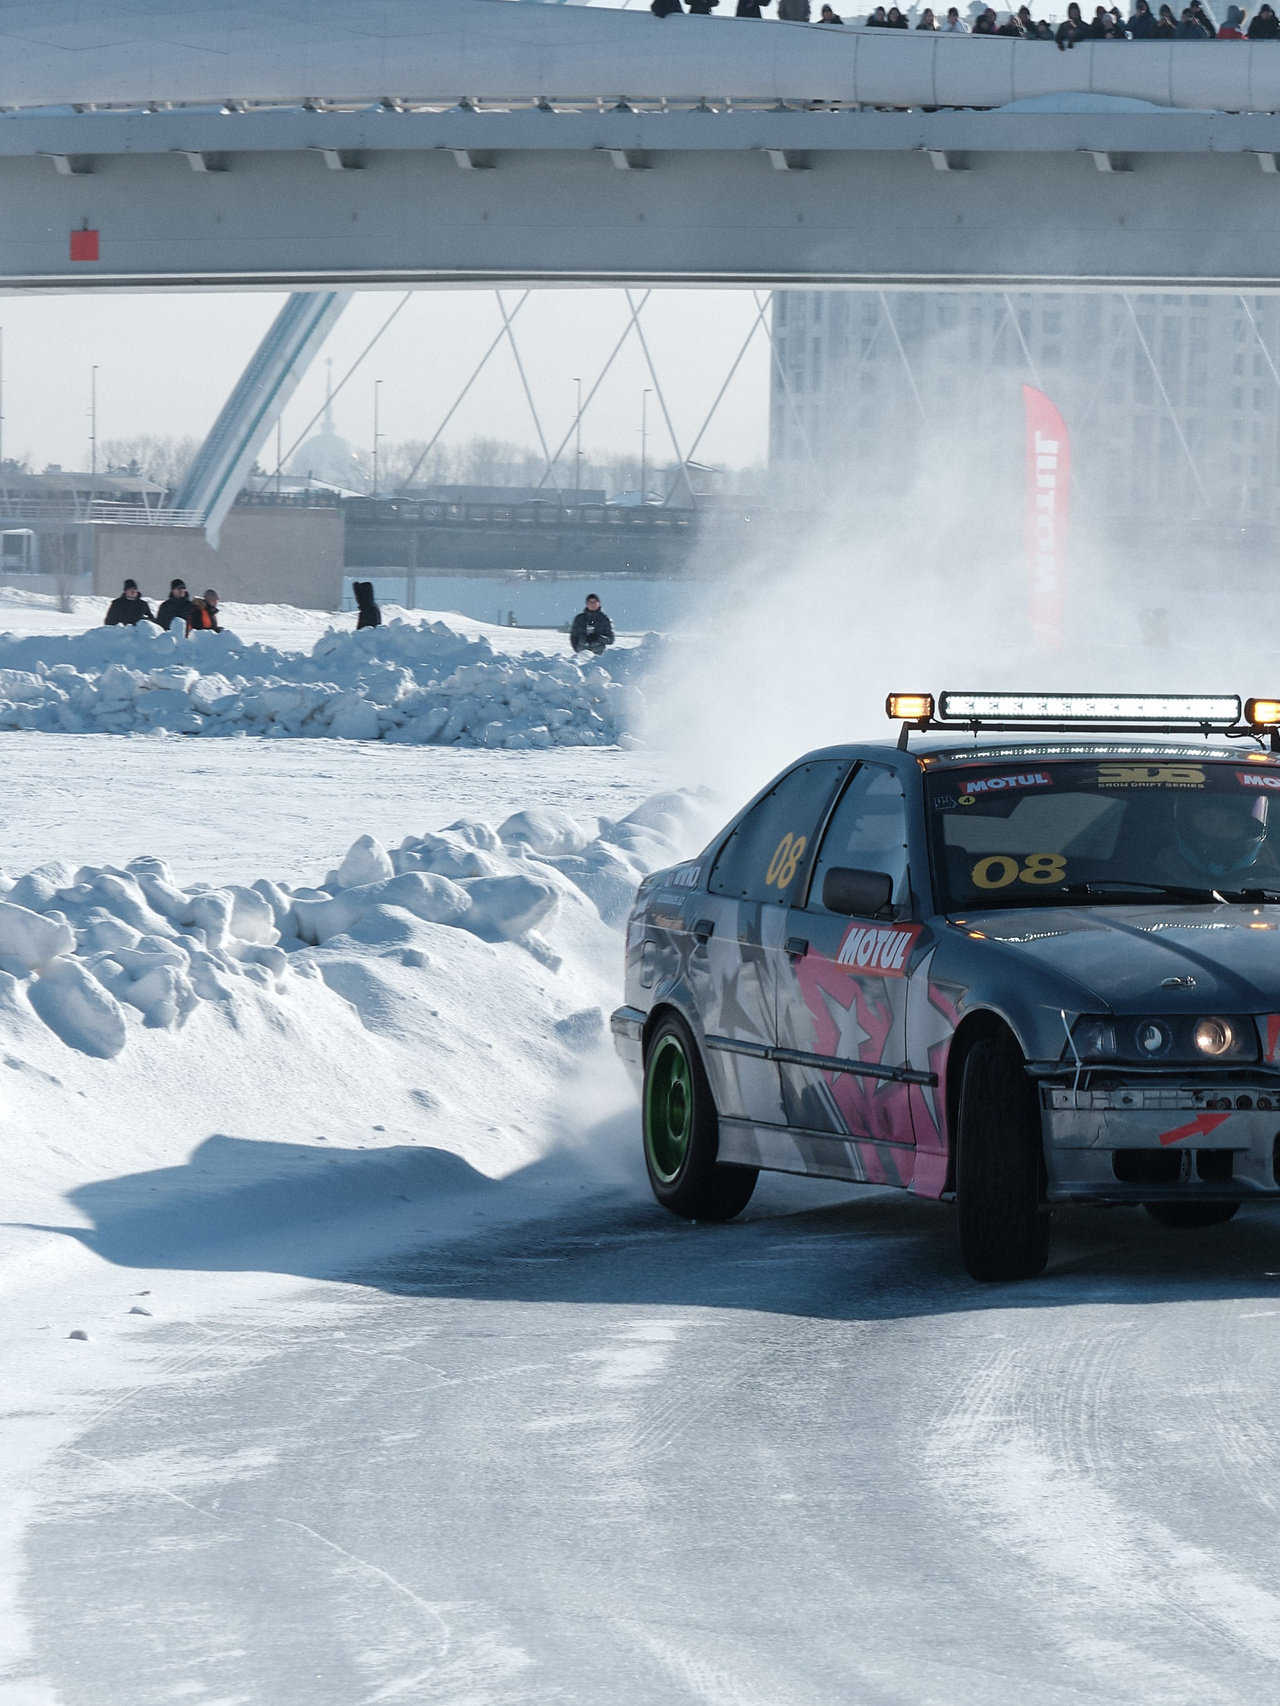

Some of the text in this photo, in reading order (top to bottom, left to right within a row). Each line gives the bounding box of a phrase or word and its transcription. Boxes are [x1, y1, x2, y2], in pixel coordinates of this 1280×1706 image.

[966, 773, 1048, 793] MOTUL
[765, 832, 806, 889] 08
[971, 853, 1067, 889] 08
[837, 927, 913, 970] MOTUL
